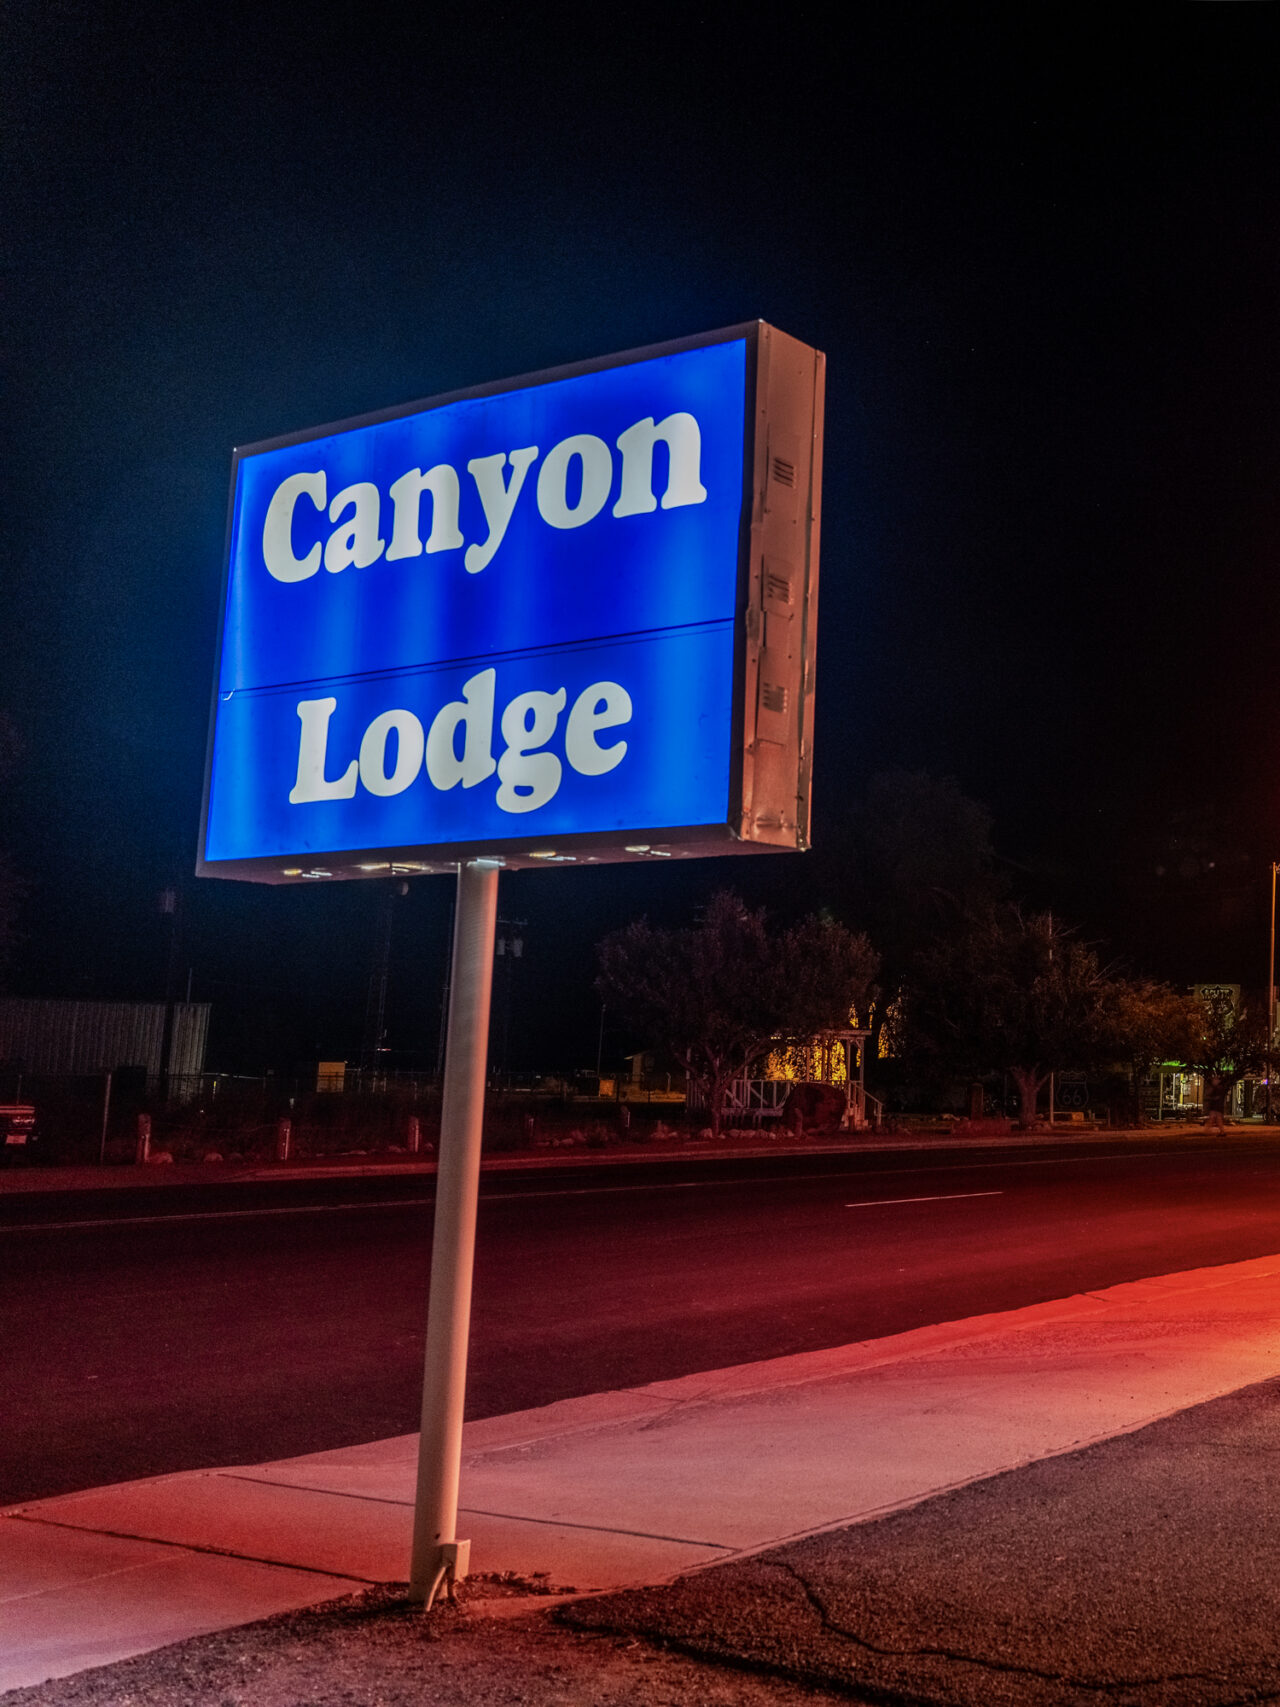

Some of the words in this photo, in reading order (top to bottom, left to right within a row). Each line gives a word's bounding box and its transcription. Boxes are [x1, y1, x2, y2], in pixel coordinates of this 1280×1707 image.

[262, 411, 707, 584] Canyon
[288, 667, 633, 814] Lodge
[1062, 1087, 1081, 1106] 66
